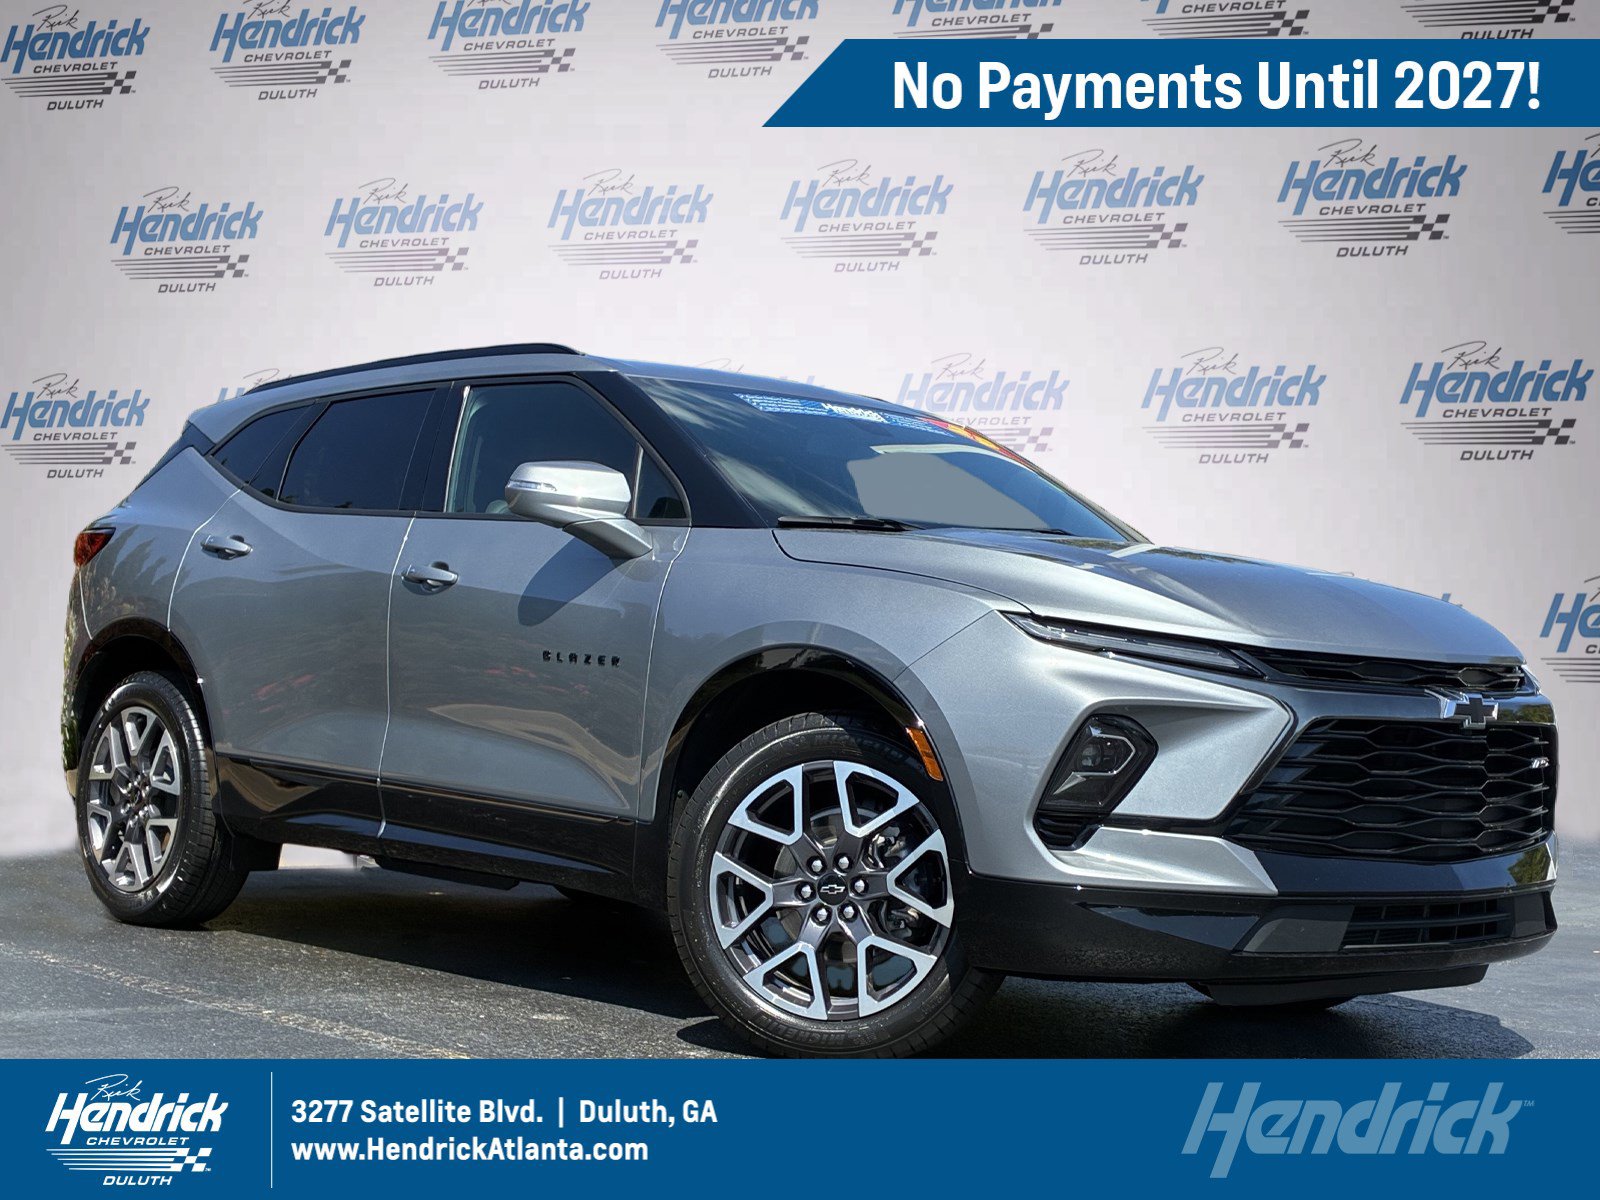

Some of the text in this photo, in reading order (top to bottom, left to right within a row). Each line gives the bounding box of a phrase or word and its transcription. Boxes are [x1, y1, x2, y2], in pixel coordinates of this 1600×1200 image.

[1182, 0, 1287, 13] CHEVROLET
[427, 0, 591, 51] Hendrick
[932, 13, 1032, 27] CHEVROLET
[209, 6, 366, 63] Hendrick
[692, 26, 788, 39] CHEVROLET
[1461, 28, 1534, 39] DULUTH
[0, 19, 150, 74] Hendrick
[464, 38, 555, 51] CHEVROLET
[244, 50, 332, 63] CHEVROLET
[33, 61, 118, 74] CHEVROLET
[708, 66, 773, 79] DULUTH
[478, 77, 540, 90] DULUTH
[258, 88, 318, 101] DULUTH
[46, 98, 104, 111] DULUTH
[1277, 154, 1468, 216] Hendrick
[1023, 164, 1205, 224] Hendrick
[780, 174, 954, 233] Hendrick
[1319, 203, 1427, 216] CHEVROLET
[547, 184, 714, 241] Hendrick
[1063, 212, 1166, 225] CHEVROLET
[324, 192, 484, 249] Hendrick
[818, 221, 917, 233] CHEVROLET
[110, 201, 264, 256] Hendrick
[584, 229, 679, 241] CHEVROLET
[359, 237, 450, 249] CHEVROLET
[143, 244, 231, 256] CHEVROLET
[1336, 245, 1409, 258] DULUTH
[1079, 253, 1149, 266] DULUTH
[834, 260, 900, 273] DULUTH
[599, 268, 662, 280] DULUTH
[373, 275, 435, 287] DULUTH
[157, 282, 217, 294] DULUTH
[897, 370, 1071, 412] Hendrick
[1141, 364, 1328, 422] Hendrick
[1399, 359, 1595, 418] Hendrick
[0, 389, 150, 441] Hendrick
[1182, 411, 1287, 423] CHEVROLET
[1442, 407, 1552, 418] CHEVROLET
[33, 431, 118, 442] CHEVROLET
[1198, 452, 1270, 464] DULUTH
[1460, 449, 1535, 461] DULUTH
[46, 468, 104, 479] DULUTH
[542, 650, 620, 667] BLAZER
